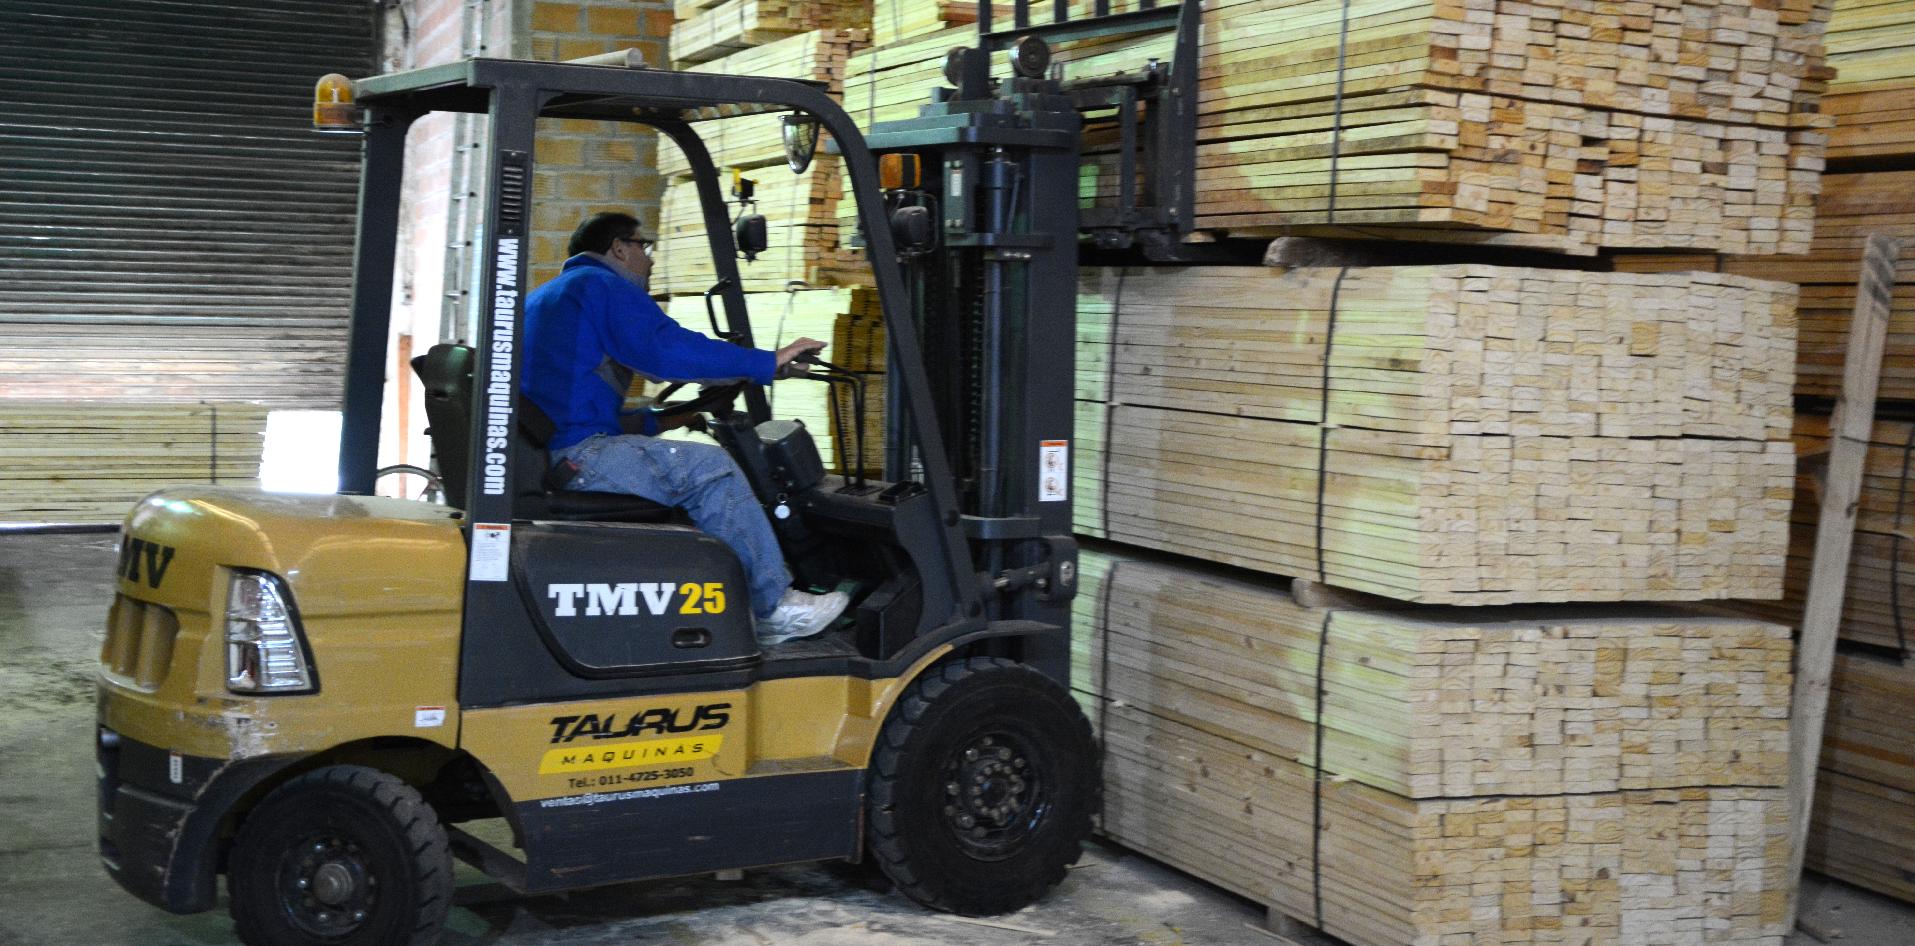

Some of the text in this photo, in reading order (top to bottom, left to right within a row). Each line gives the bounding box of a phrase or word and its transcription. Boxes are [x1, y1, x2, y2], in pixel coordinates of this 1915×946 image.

[483, 238, 519, 495] www.taurusmaquinas.com
[118, 533, 176, 589] MV
[550, 703, 732, 744] TAURUS
[561, 743, 704, 765] MAQUINAS
[599, 767, 694, 786] 011-4725-3050
